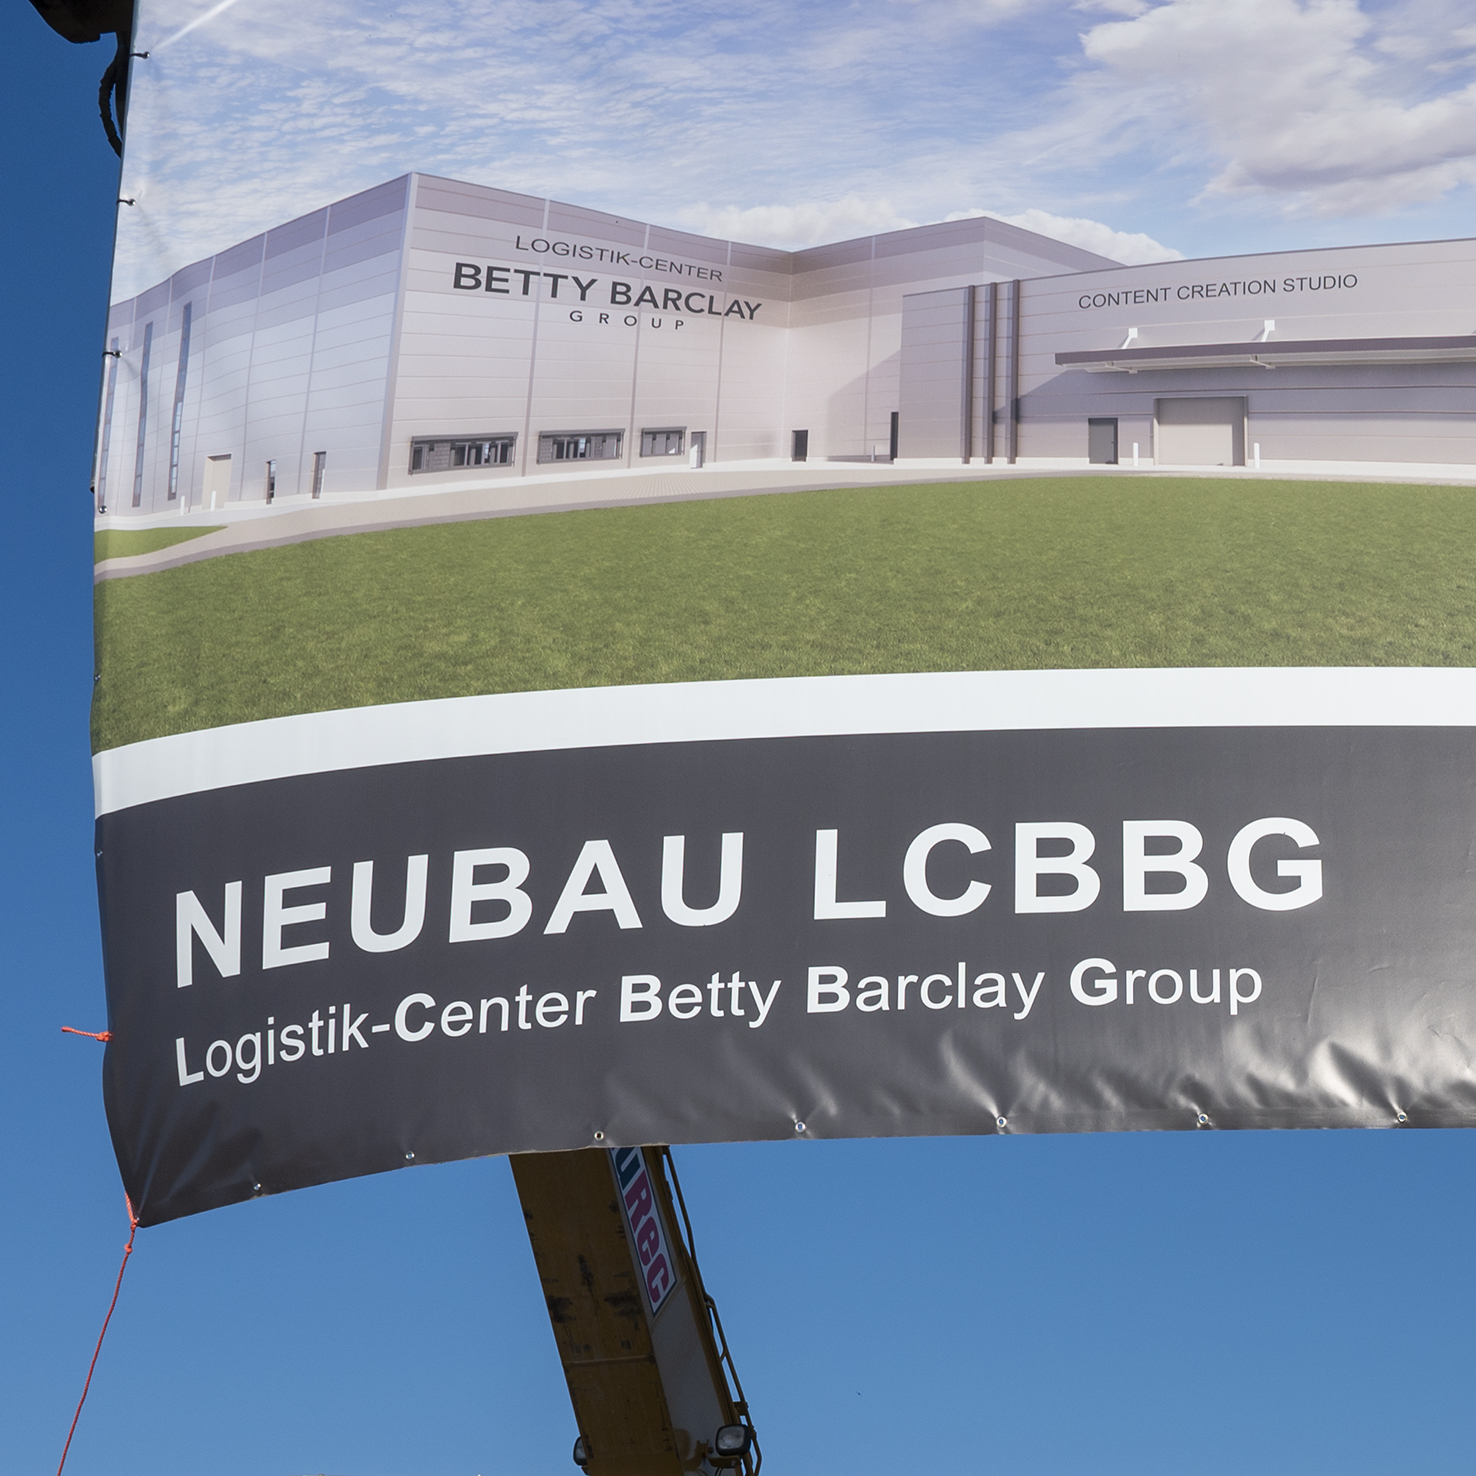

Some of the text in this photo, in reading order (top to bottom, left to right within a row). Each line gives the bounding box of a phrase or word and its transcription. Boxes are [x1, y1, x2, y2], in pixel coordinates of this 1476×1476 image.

[516, 233, 722, 282] LOGISTIK-CENTER
[453, 262, 761, 320] BETTY BARCLAY
[1079, 273, 1358, 309] CONTENT CREATION STUDIO
[570, 311, 683, 330] GROUP
[177, 818, 1322, 988] NEUBAU LCBBG
[176, 958, 1262, 1086] Logistik-Center Betty Barclay Group
